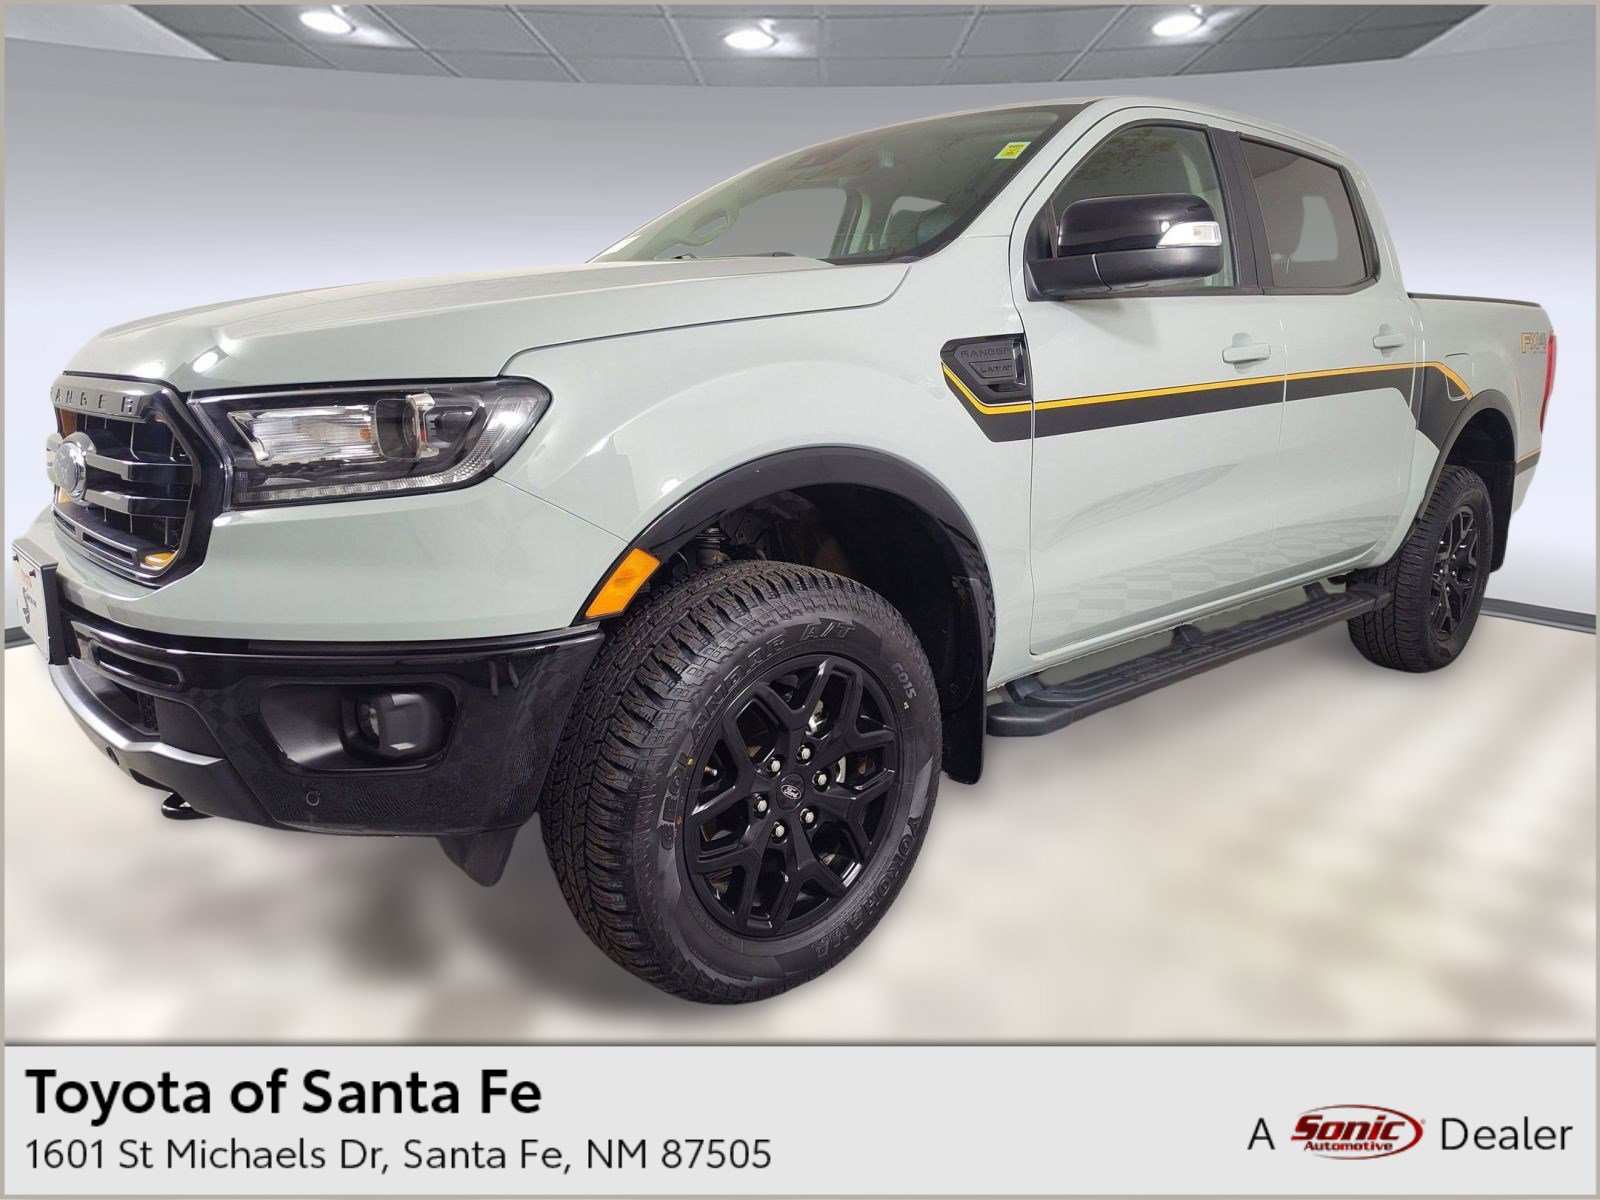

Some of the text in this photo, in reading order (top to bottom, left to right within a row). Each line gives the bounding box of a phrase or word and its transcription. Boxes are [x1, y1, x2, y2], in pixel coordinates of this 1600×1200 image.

[960, 346, 1011, 359] RANGER
[802, 622, 856, 642] A/T
[811, 815, 922, 960] YOKOHAMA
